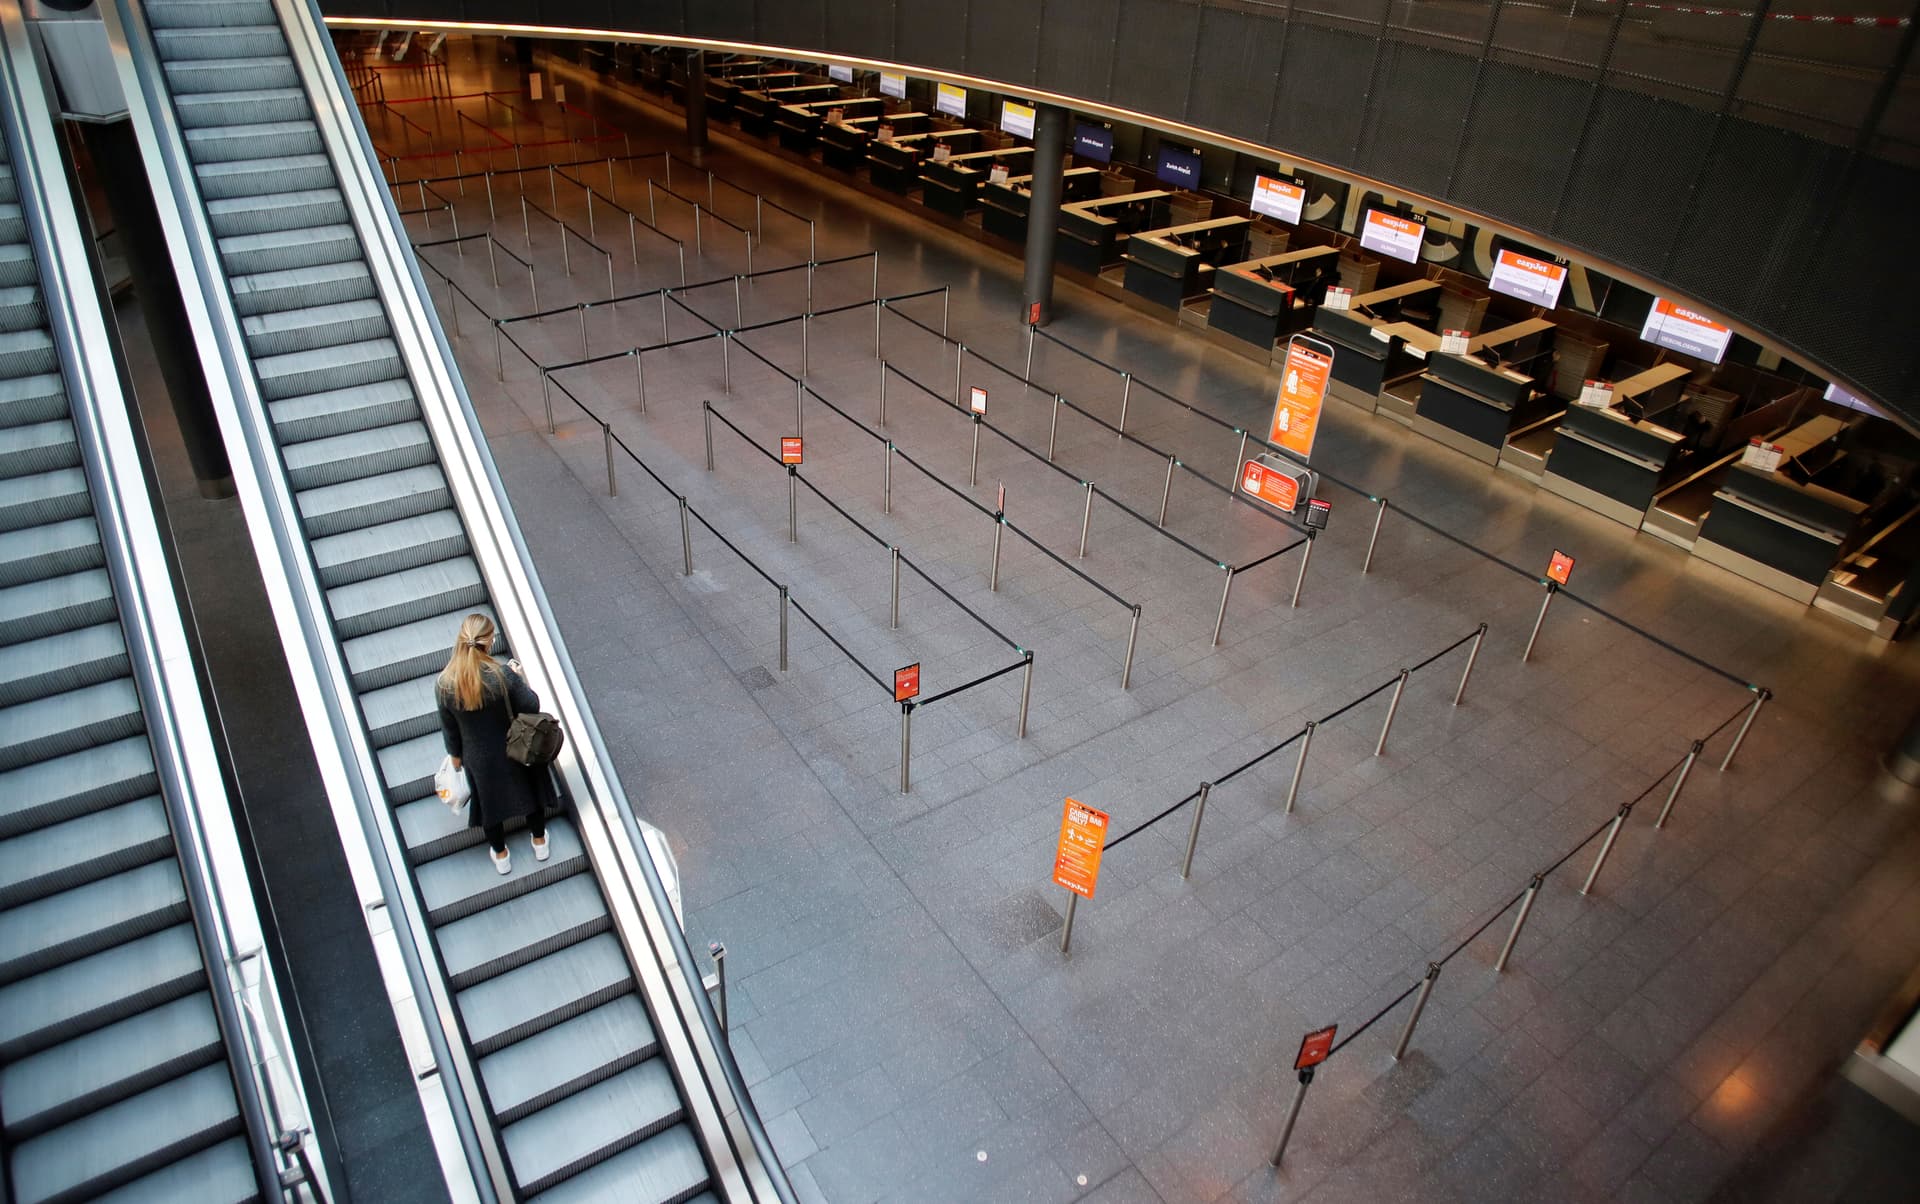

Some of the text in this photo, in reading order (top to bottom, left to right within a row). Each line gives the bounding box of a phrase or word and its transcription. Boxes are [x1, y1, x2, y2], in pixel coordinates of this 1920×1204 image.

[1268, 182, 1292, 194] easyJet
[1294, 178, 1304, 186] 315
[1381, 217, 1409, 230] easyJet
[1413, 214, 1424, 222] 314
[1516, 258, 1548, 273] easyJet
[1069, 808, 1089, 820] CABIN
[1089, 817, 1102, 827] BAG
[1058, 877, 1088, 893] easyJet
